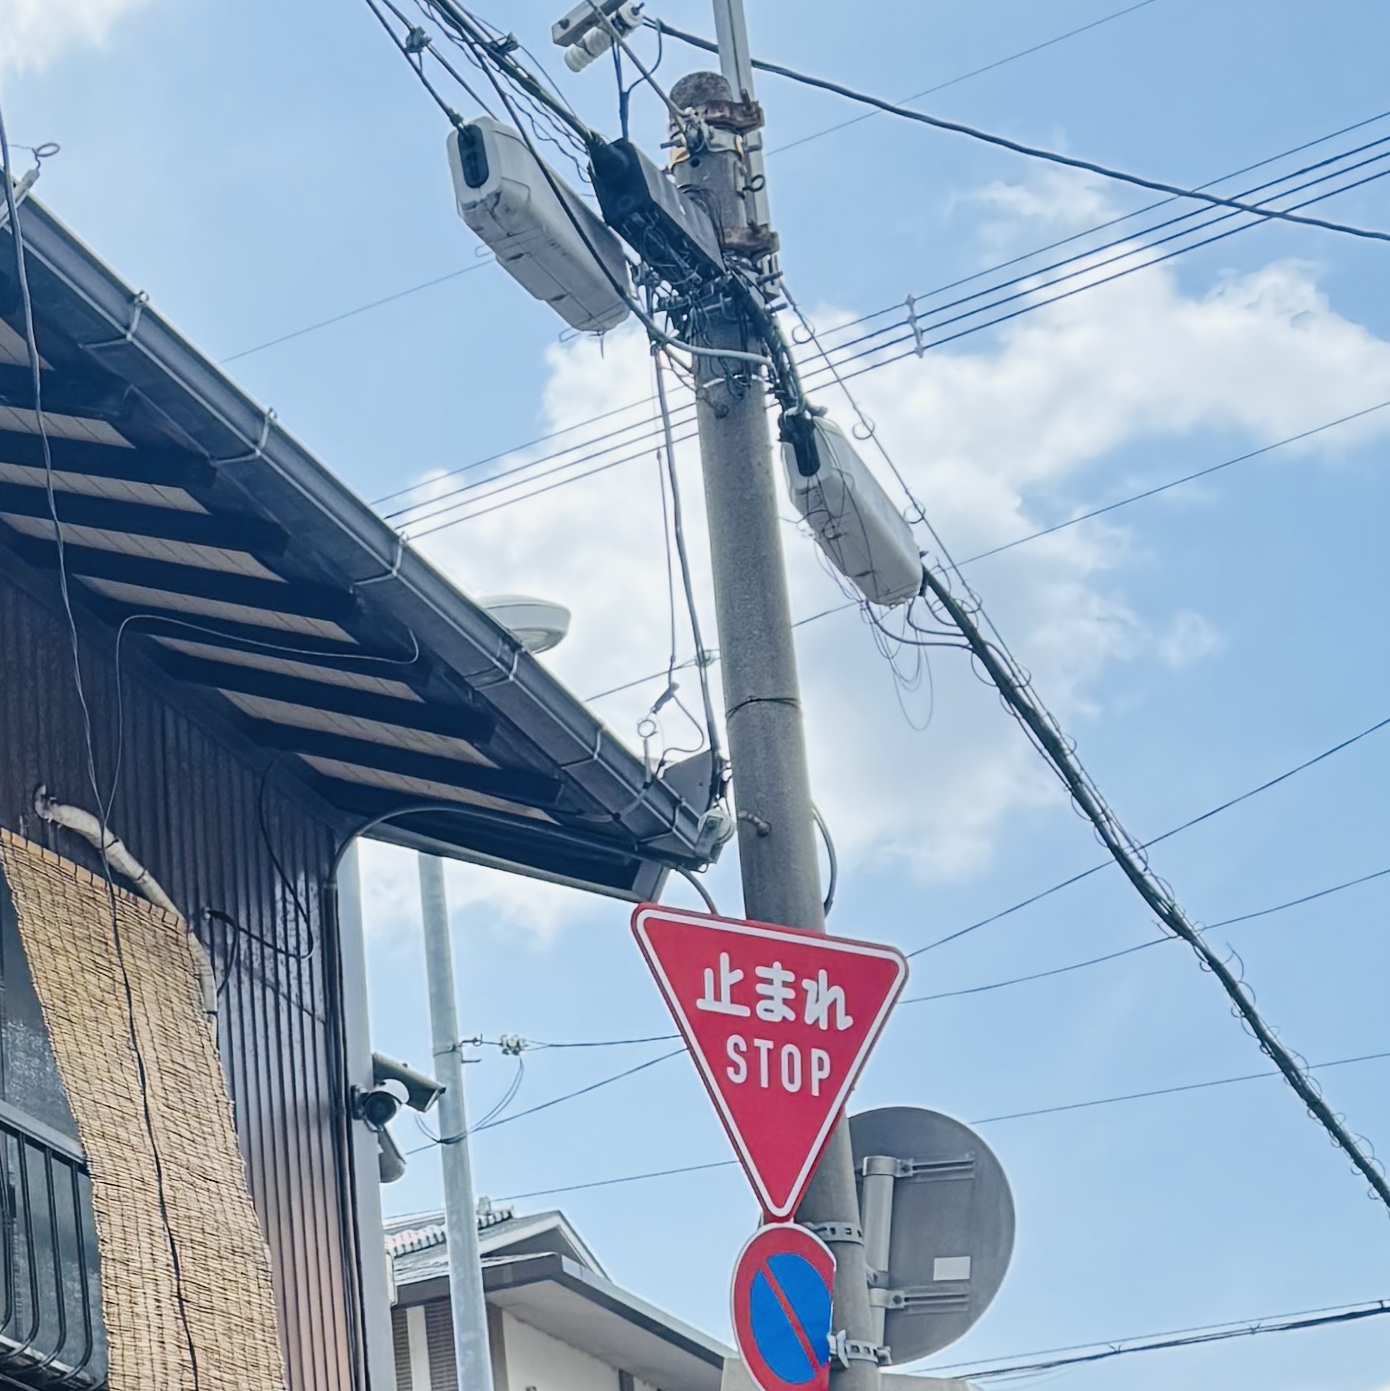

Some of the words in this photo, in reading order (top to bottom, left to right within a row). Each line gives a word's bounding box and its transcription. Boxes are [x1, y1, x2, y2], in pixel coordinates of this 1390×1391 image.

[695, 951, 854, 1031] 止まれ
[726, 1033, 831, 1097] STOP
